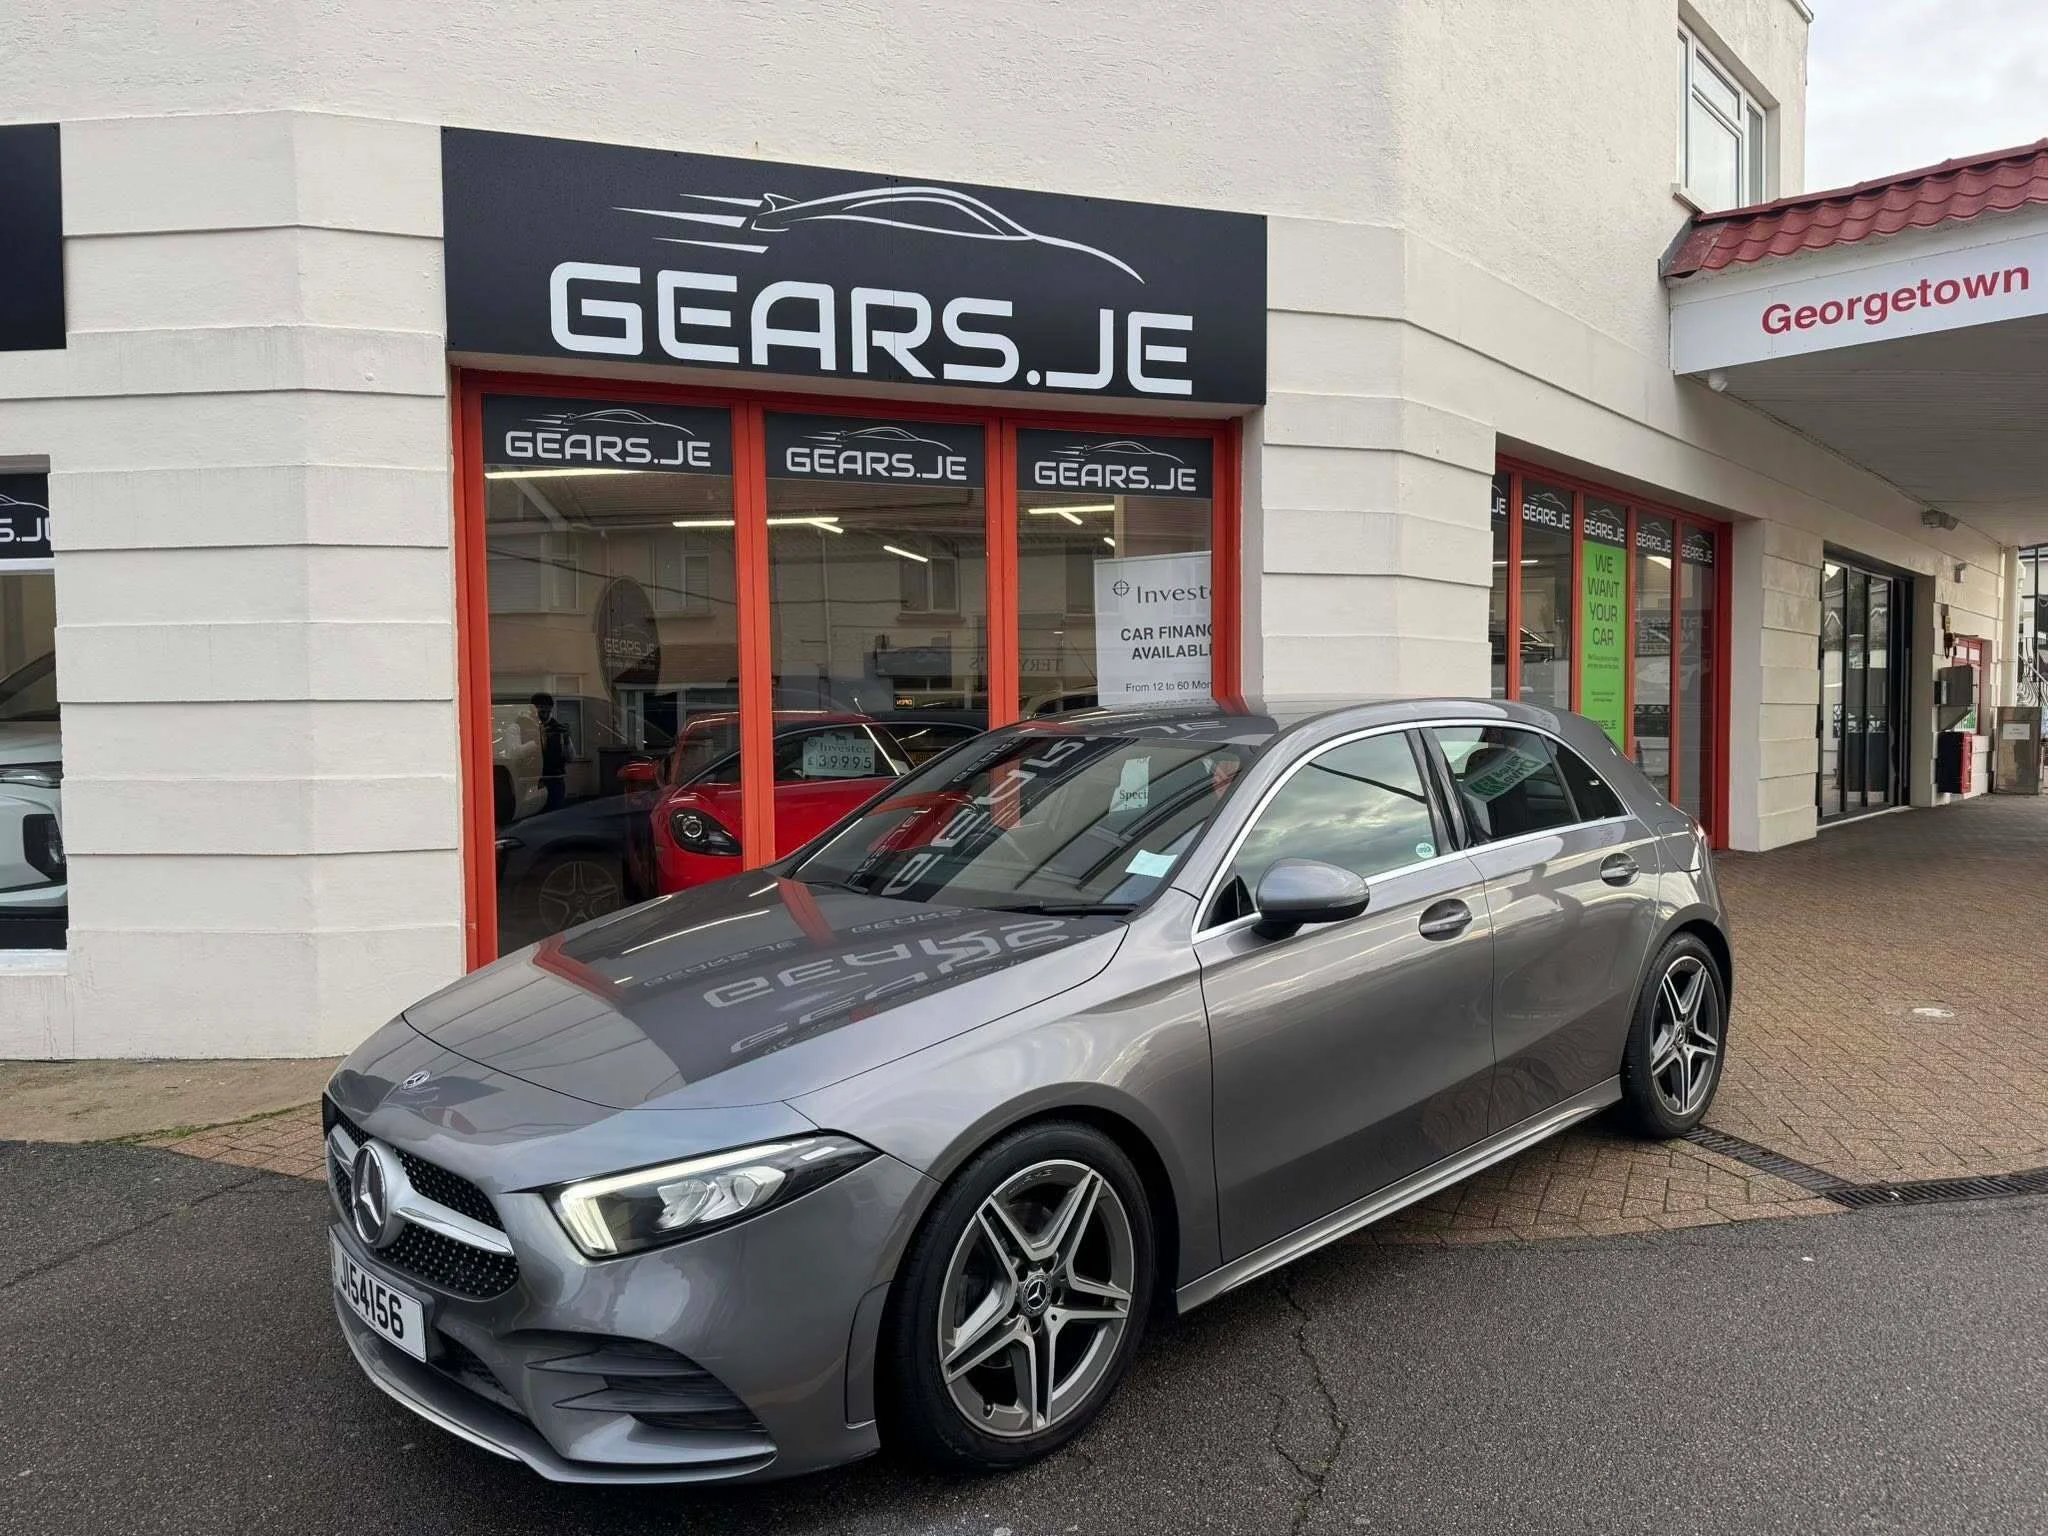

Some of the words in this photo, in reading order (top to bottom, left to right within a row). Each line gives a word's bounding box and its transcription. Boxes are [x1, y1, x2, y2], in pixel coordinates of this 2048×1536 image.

[1761, 266, 2030, 335] Georgetown
[550, 261, 1192, 396] GEARS.JE
[505, 430, 712, 467] GEARS.JE
[786, 447, 967, 481] GEARS.JE
[1034, 461, 1197, 491] GEARS.JE
[1595, 554, 1614, 574] WE
[1587, 578, 1620, 598] WANT
[1589, 603, 1618, 622] YOUR
[1120, 627, 1154, 642] CAR
[1592, 627, 1615, 646] CAR
[1126, 682, 1150, 692] From
[1153, 681, 1164, 691] 12
[1166, 681, 1175, 690] to
[1177, 680, 1189, 690] 60
[341, 1251, 404, 1341] J154156
